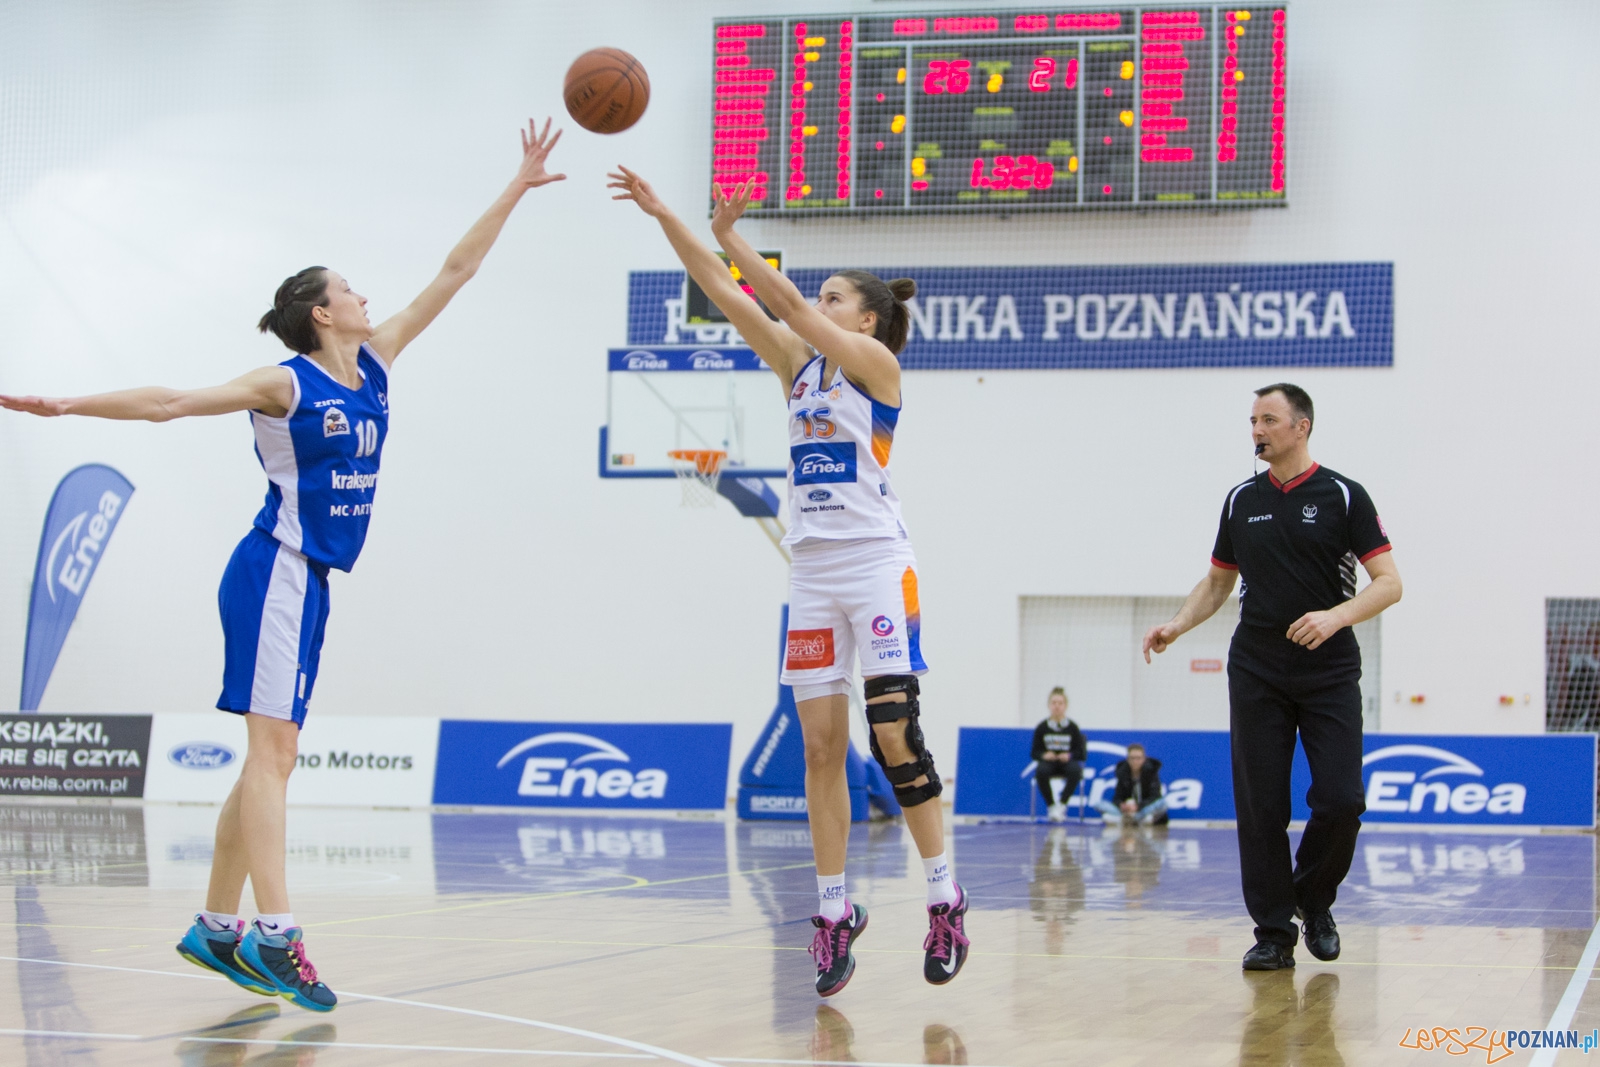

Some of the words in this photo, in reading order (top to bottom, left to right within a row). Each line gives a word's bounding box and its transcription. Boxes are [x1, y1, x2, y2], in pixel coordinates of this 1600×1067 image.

[923, 60, 971, 94] 26
[1029, 57, 1079, 92] 21
[1042, 283, 1355, 340] POZNAŃSKA
[354, 419, 378, 457] 10
[795, 407, 837, 440] 15
[802, 461, 846, 475] Enea
[58, 490, 122, 597] Enea
[871, 636, 899, 646] POZNAŃ
[33, 749, 68, 770] SIĘ
[73, 749, 141, 767] CZYTA
[327, 751, 413, 770] Motors
[517, 757, 668, 799] Enea
[1365, 771, 1527, 815] Enea
